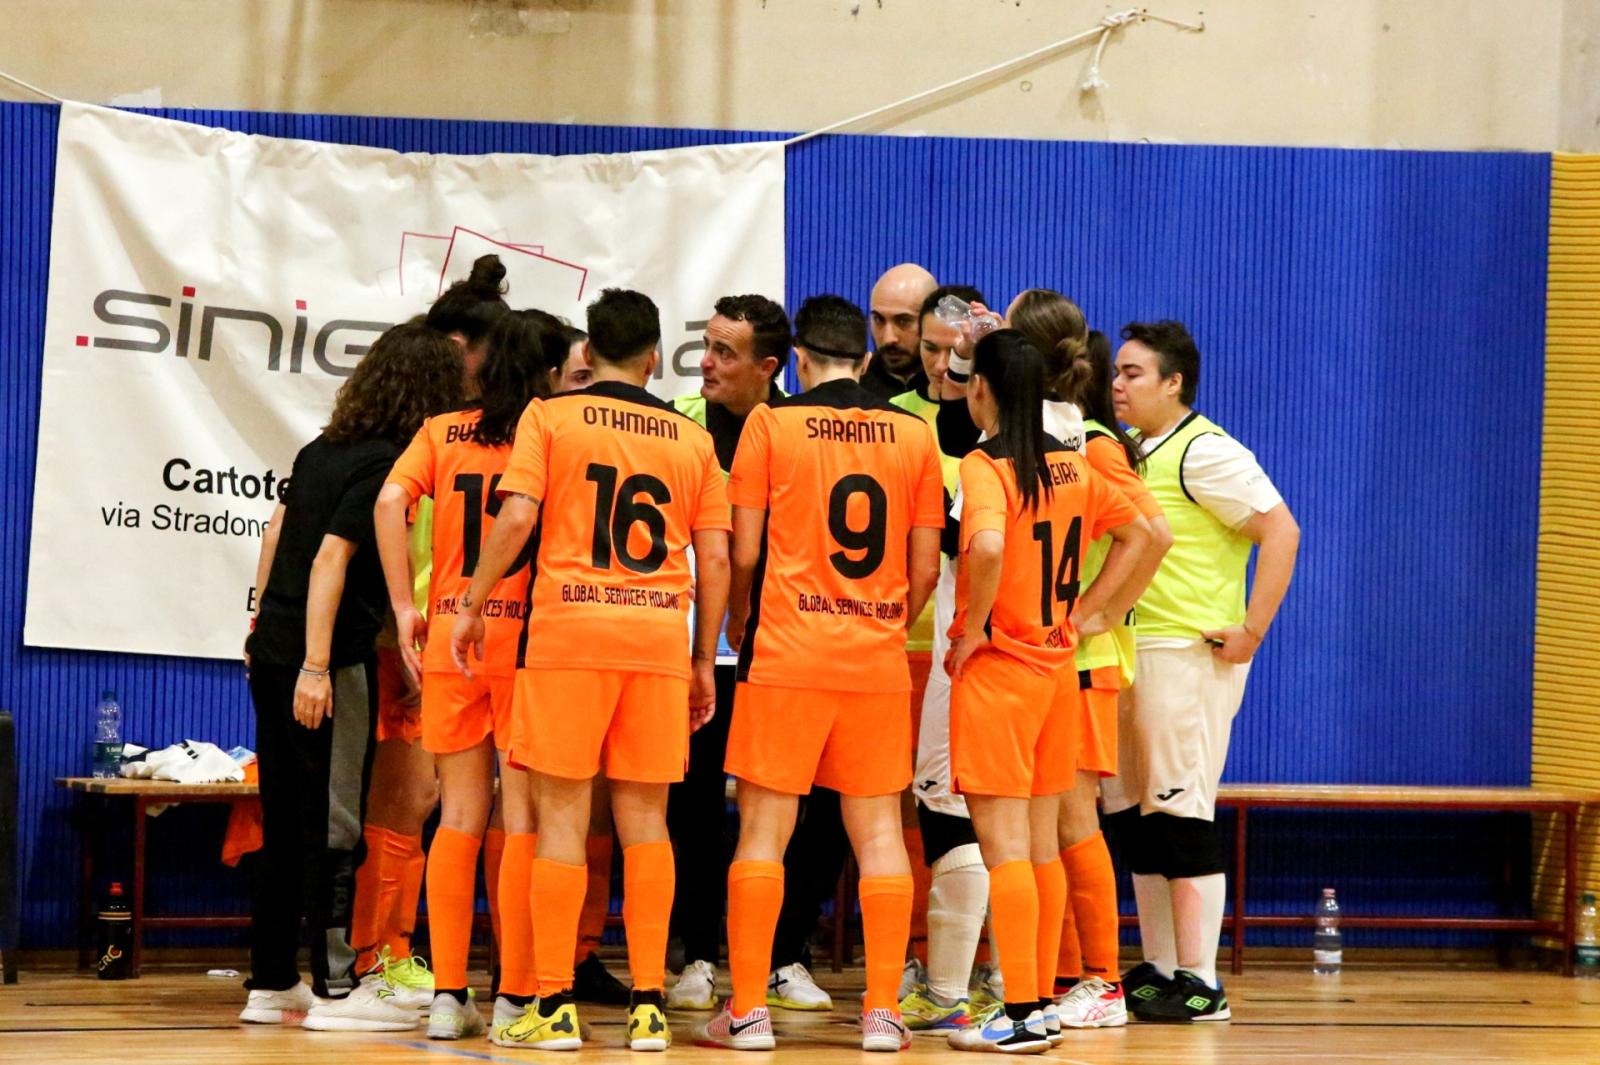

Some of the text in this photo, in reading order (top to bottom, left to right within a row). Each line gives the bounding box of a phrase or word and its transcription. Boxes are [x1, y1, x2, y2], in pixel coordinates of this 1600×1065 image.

[583, 406, 679, 441] OTHMANI
[806, 417, 896, 444] SARANITI
[163, 458, 292, 503] Cartote
[1047, 461, 1081, 486] EIRA
[101, 501, 140, 528] via
[585, 462, 672, 574] 16
[828, 473, 888, 580] 9
[1033, 516, 1082, 627] 14
[562, 584, 601, 603] GLOBAL
[604, 587, 646, 606] SERVICES
[797, 593, 835, 614] GLOBAL
